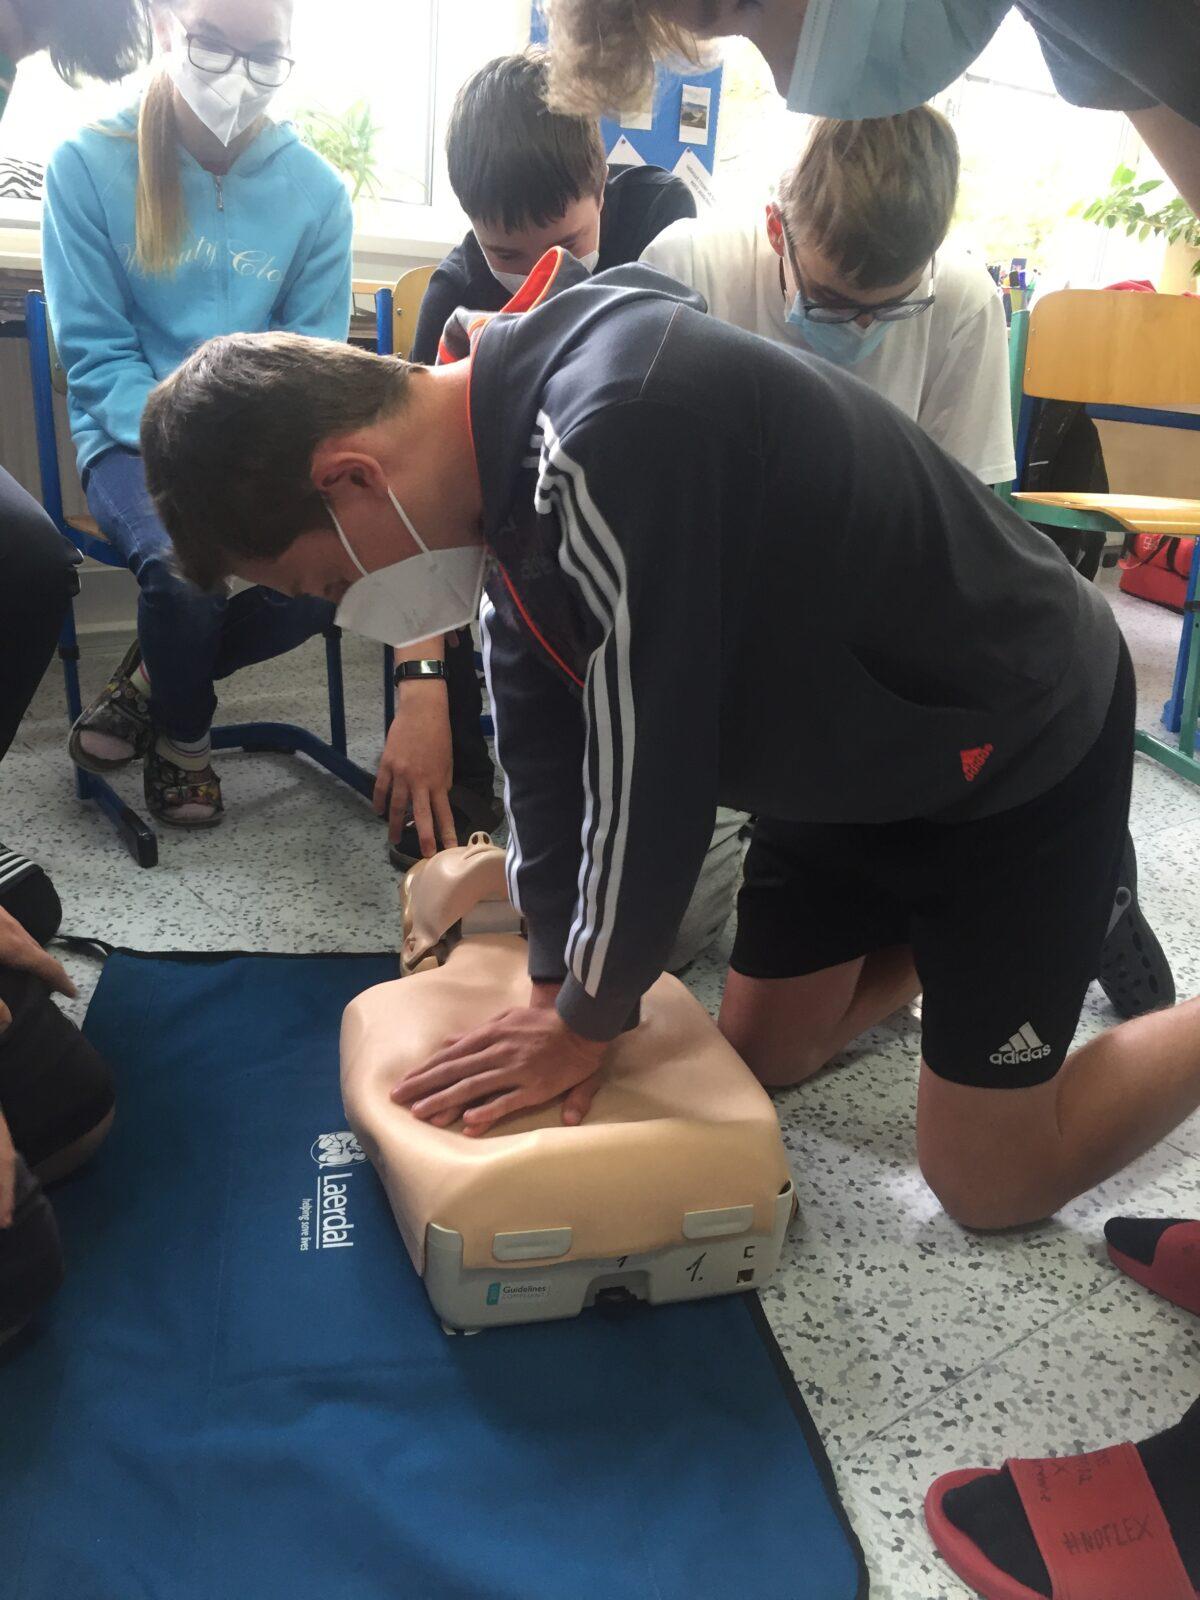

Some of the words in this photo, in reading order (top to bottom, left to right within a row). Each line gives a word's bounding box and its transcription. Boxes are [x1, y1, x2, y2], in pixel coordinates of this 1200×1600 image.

[989, 1044, 1052, 1065] adidas
[298, 1198, 313, 1221] helping
[322, 1172, 355, 1249] Laerdal
[300, 1221, 310, 1236] save
[299, 1236, 312, 1251] lives
[502, 1285, 546, 1294] Guidelines
